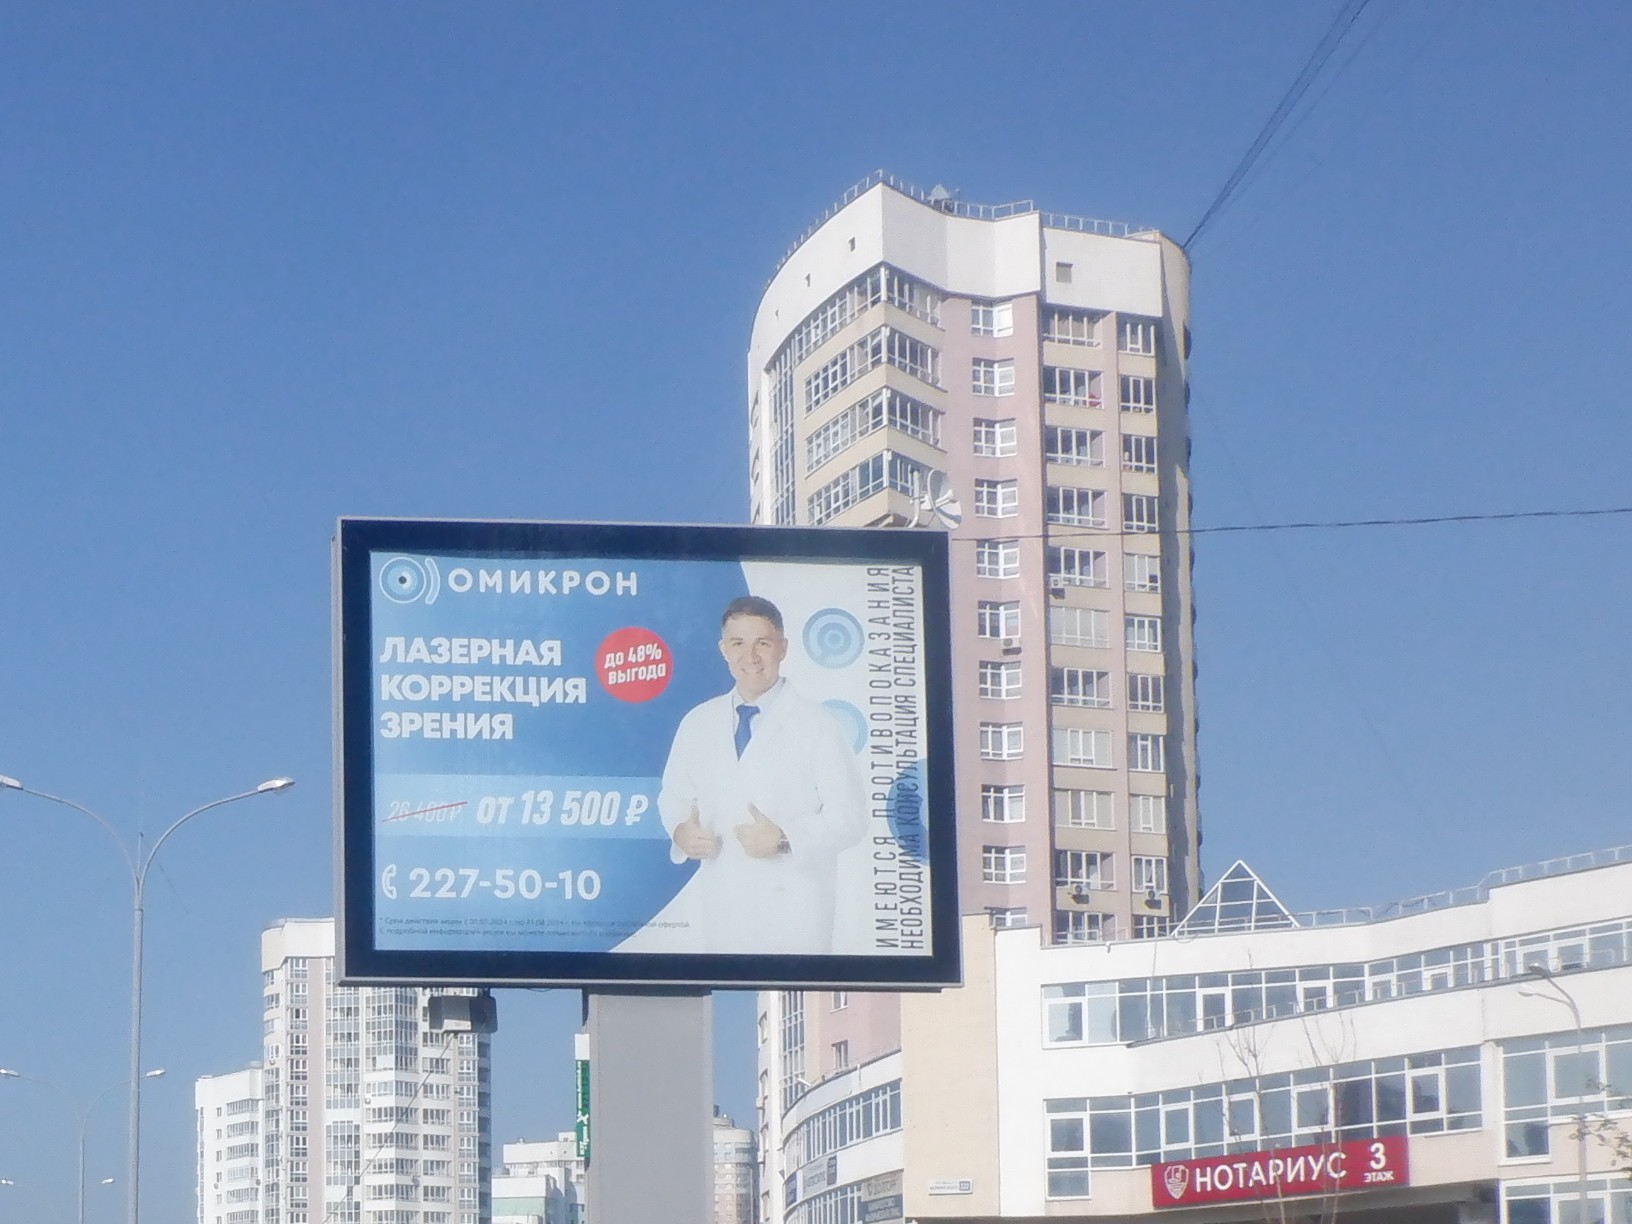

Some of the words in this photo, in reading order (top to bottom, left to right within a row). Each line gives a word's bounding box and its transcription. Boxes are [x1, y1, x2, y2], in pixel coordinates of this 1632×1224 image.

[447, 568, 638, 596] ОМИКРОН
[891, 566, 917, 688] СПЕЦИАЛИСТА
[379, 636, 562, 667] ЛАЗЕРНАЯ
[627, 643, 663, 663] 48%
[380, 674, 587, 707] КОРРЕКЦИЯ
[867, 567, 895, 818] ПРОТИВОПОКАЗАНИЯ
[380, 711, 514, 740] ЗРЕНИЯ
[894, 694, 920, 826] КОНСУЛЬТАЦИЯ
[521, 790, 554, 826] 13
[560, 790, 621, 826] 500
[408, 868, 602, 901] 227-50-10
[873, 836, 899, 948] ИМЕЮТСЯ
[898, 834, 924, 950] НЕОБХОДИМА
[1195, 1151, 1347, 1193] НОТАРИУС
[1370, 1142, 1386, 1170] 3
[1363, 1170, 1395, 1183] ЭТАЖ
